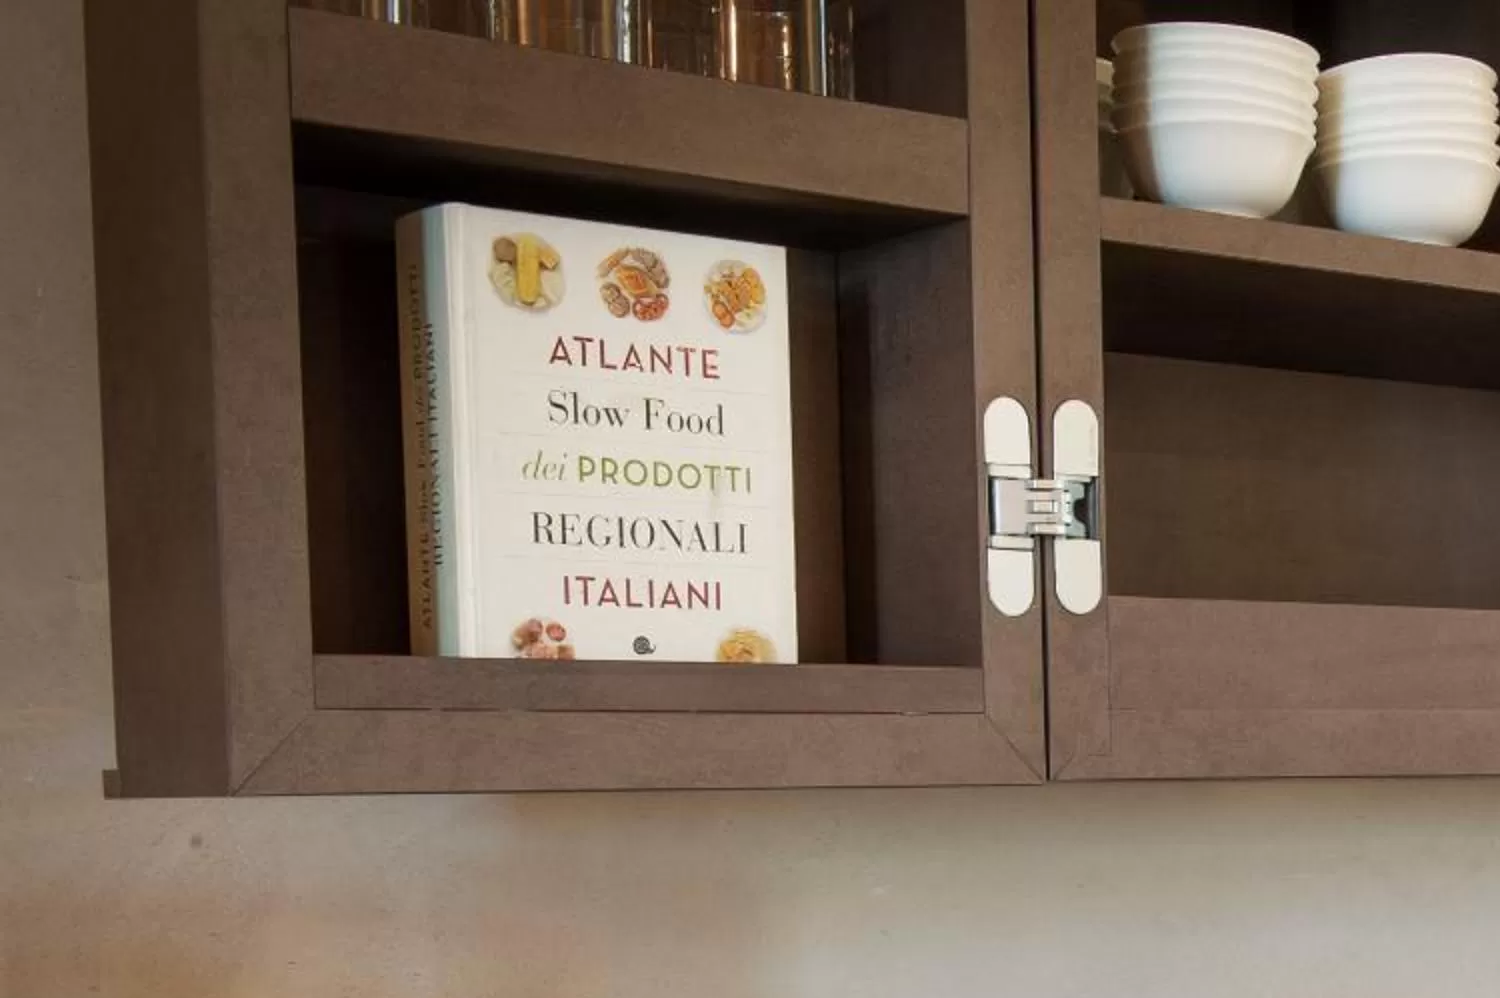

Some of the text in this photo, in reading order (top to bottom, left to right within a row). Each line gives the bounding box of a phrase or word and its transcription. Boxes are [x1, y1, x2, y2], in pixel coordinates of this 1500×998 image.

[549, 336, 721, 379] ATLANTE
[547, 389, 725, 436] Slow Food
[522, 450, 751, 493] dei PRODOTTI
[530, 512, 749, 554] REGIONALI
[563, 575, 721, 611] ITALIANI
